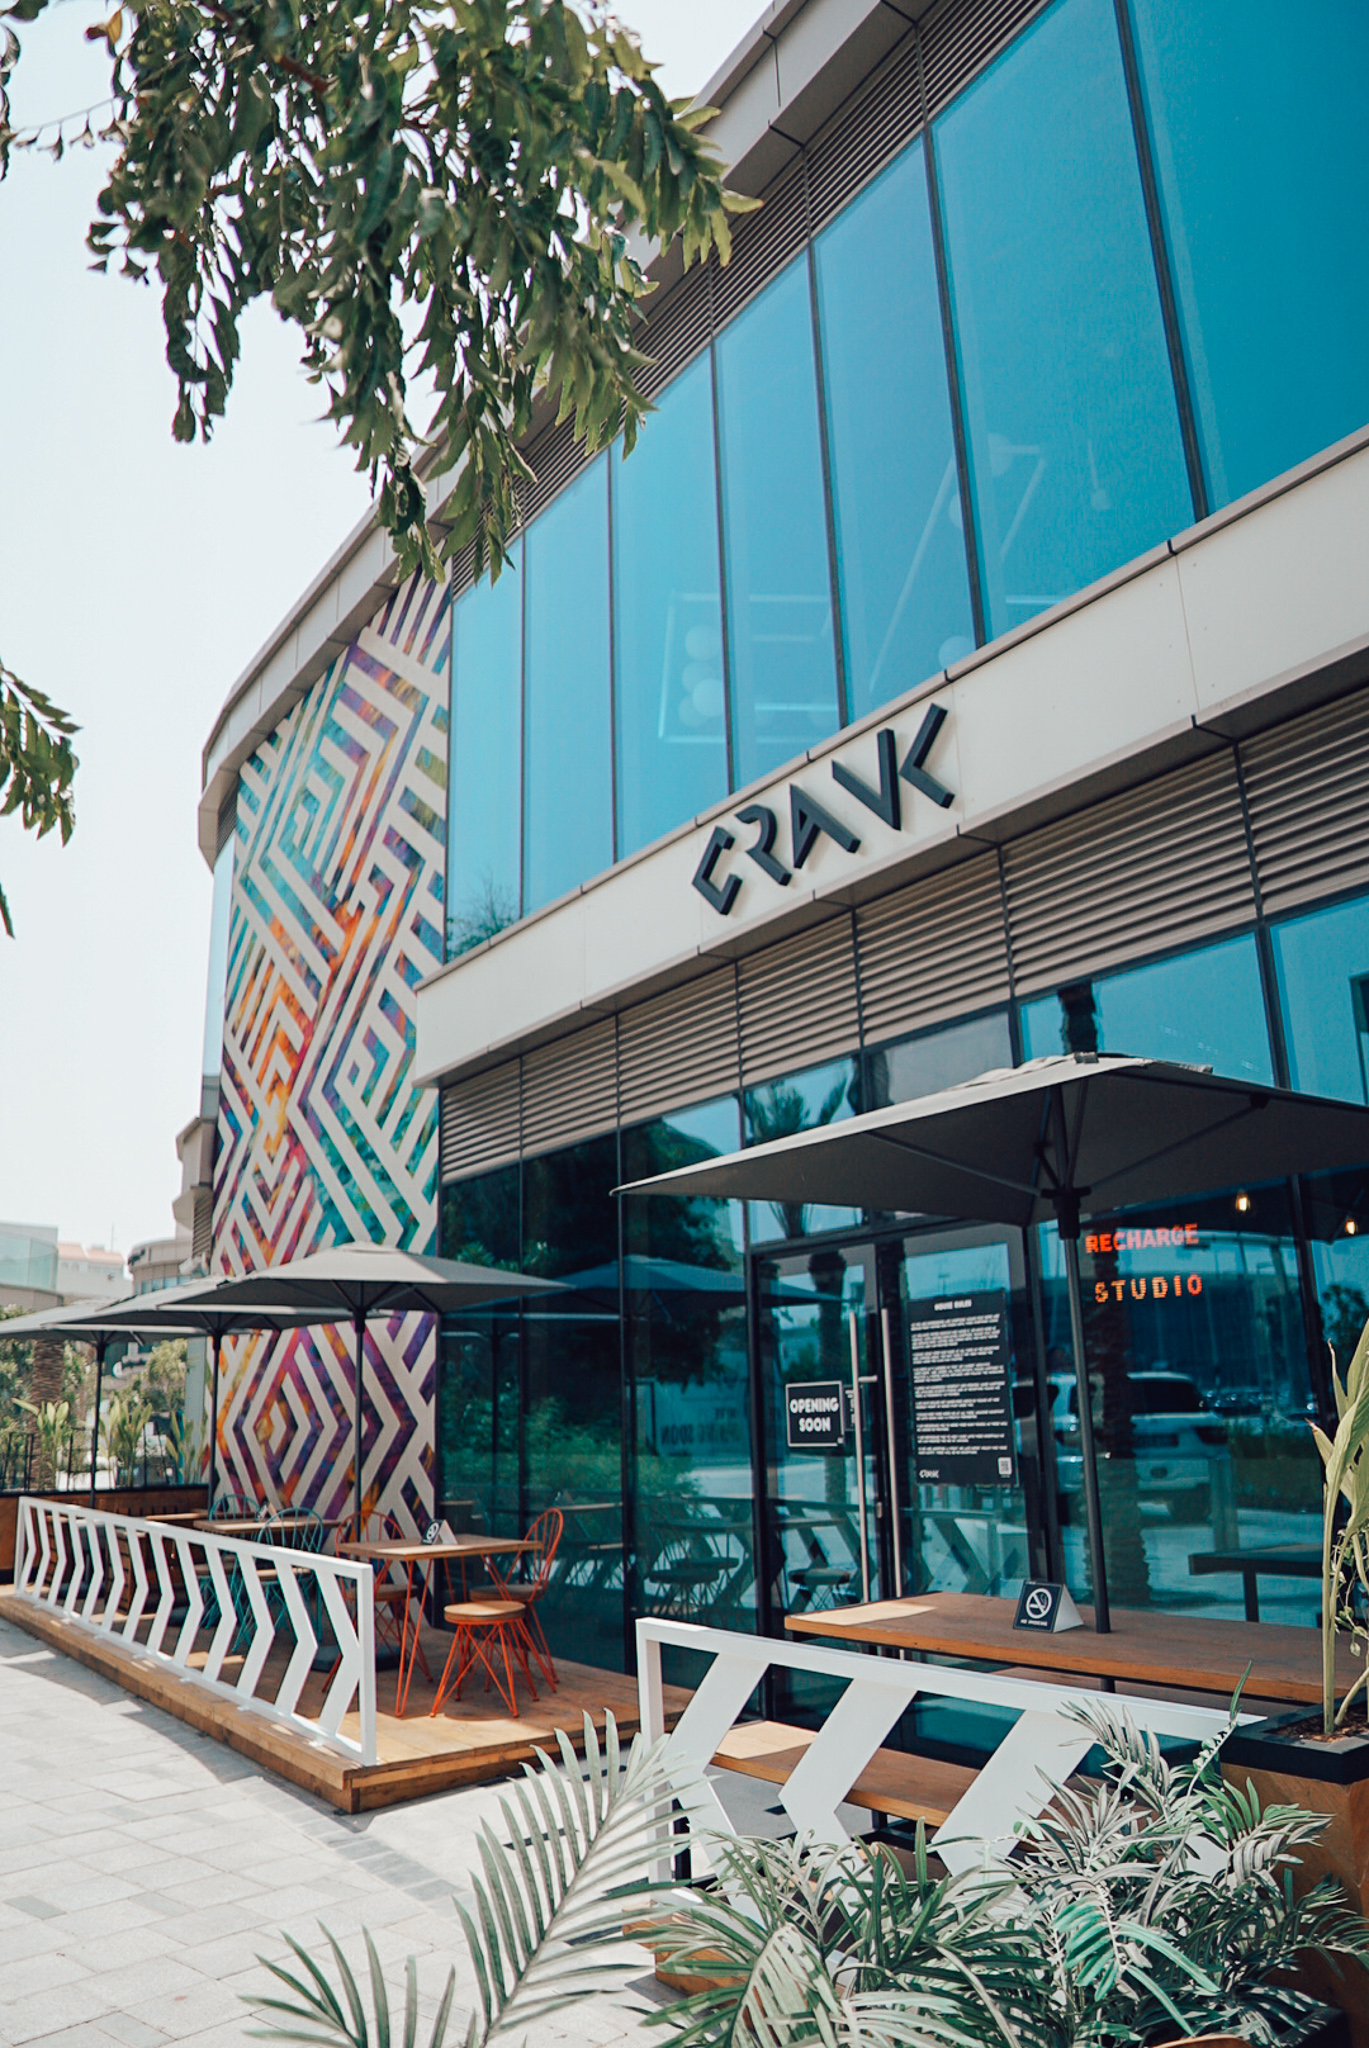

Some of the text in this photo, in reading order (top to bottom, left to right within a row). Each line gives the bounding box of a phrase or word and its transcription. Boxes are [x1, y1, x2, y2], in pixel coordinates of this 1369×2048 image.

[1085, 1224, 1200, 1253] RECHARGE
[1095, 1274, 1203, 1303] STUDIO
[790, 1398, 839, 1413] OPENING
[799, 1417, 831, 1432] SOON
